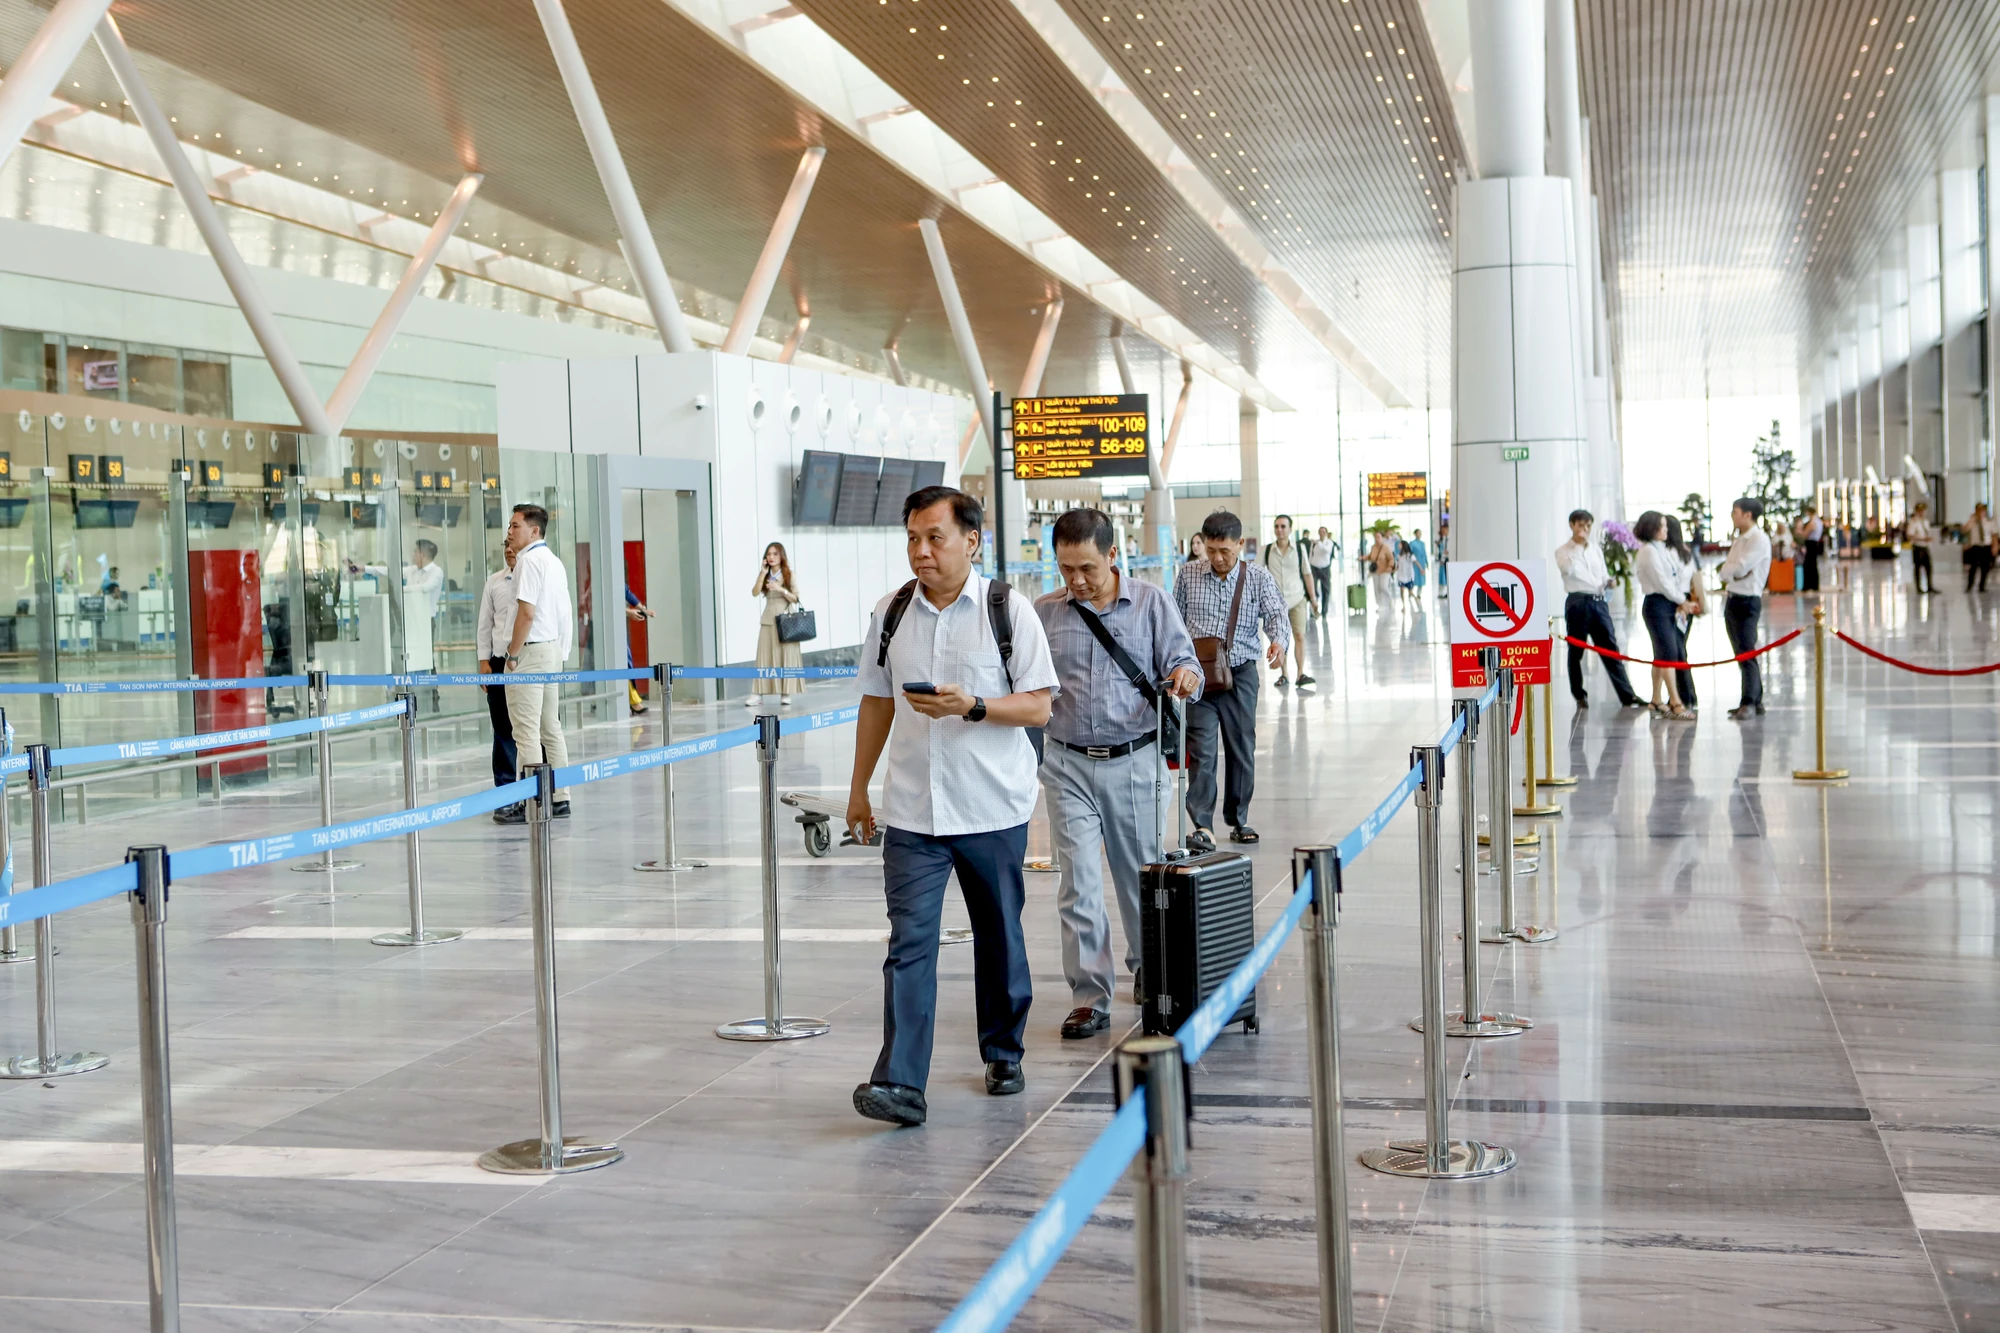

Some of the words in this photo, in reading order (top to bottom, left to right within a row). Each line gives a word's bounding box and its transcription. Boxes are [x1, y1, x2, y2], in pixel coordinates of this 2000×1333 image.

[1098, 417, 1146, 433] 100-109
[1100, 438, 1145, 454] 56-99
[1504, 449, 1521, 460] EXIT
[0, 458, 8, 474] 6
[78, 460, 92, 476] 57
[108, 461, 122, 477] 58
[208, 465, 220, 480] 60
[272, 468, 282, 482] 61
[1507, 645, 1539, 655] DÙNG
[393, 675, 413, 685] TIA
[480, 675, 497, 683] NHAT
[499, 675, 548, 683] INTERNATIONAL
[757, 668, 778, 678] TIA
[1469, 674, 1484, 685] NO
[64, 683, 83, 693] TIA
[163, 681, 209, 689] INTERNATIONAL
[211, 680, 237, 688] AIRPORT
[320, 715, 336, 729] TIA
[118, 743, 138, 758] TIA
[628, 757, 639, 768] TAN
[639, 754, 650, 766] SON
[651, 750, 663, 763] NHAT
[664, 743, 698, 760] INTERNATIONAL
[698, 739, 717, 752] AIRPORT
[1, 756, 29, 770] INTERNA
[582, 763, 600, 781] TIA
[311, 831, 329, 847] TAN
[330, 827, 348, 843] SON
[349, 822, 371, 839] NHAT
[373, 811, 430, 834] INTERNATIONAL
[431, 802, 462, 821] AIRPORT
[229, 842, 259, 867] TIA
